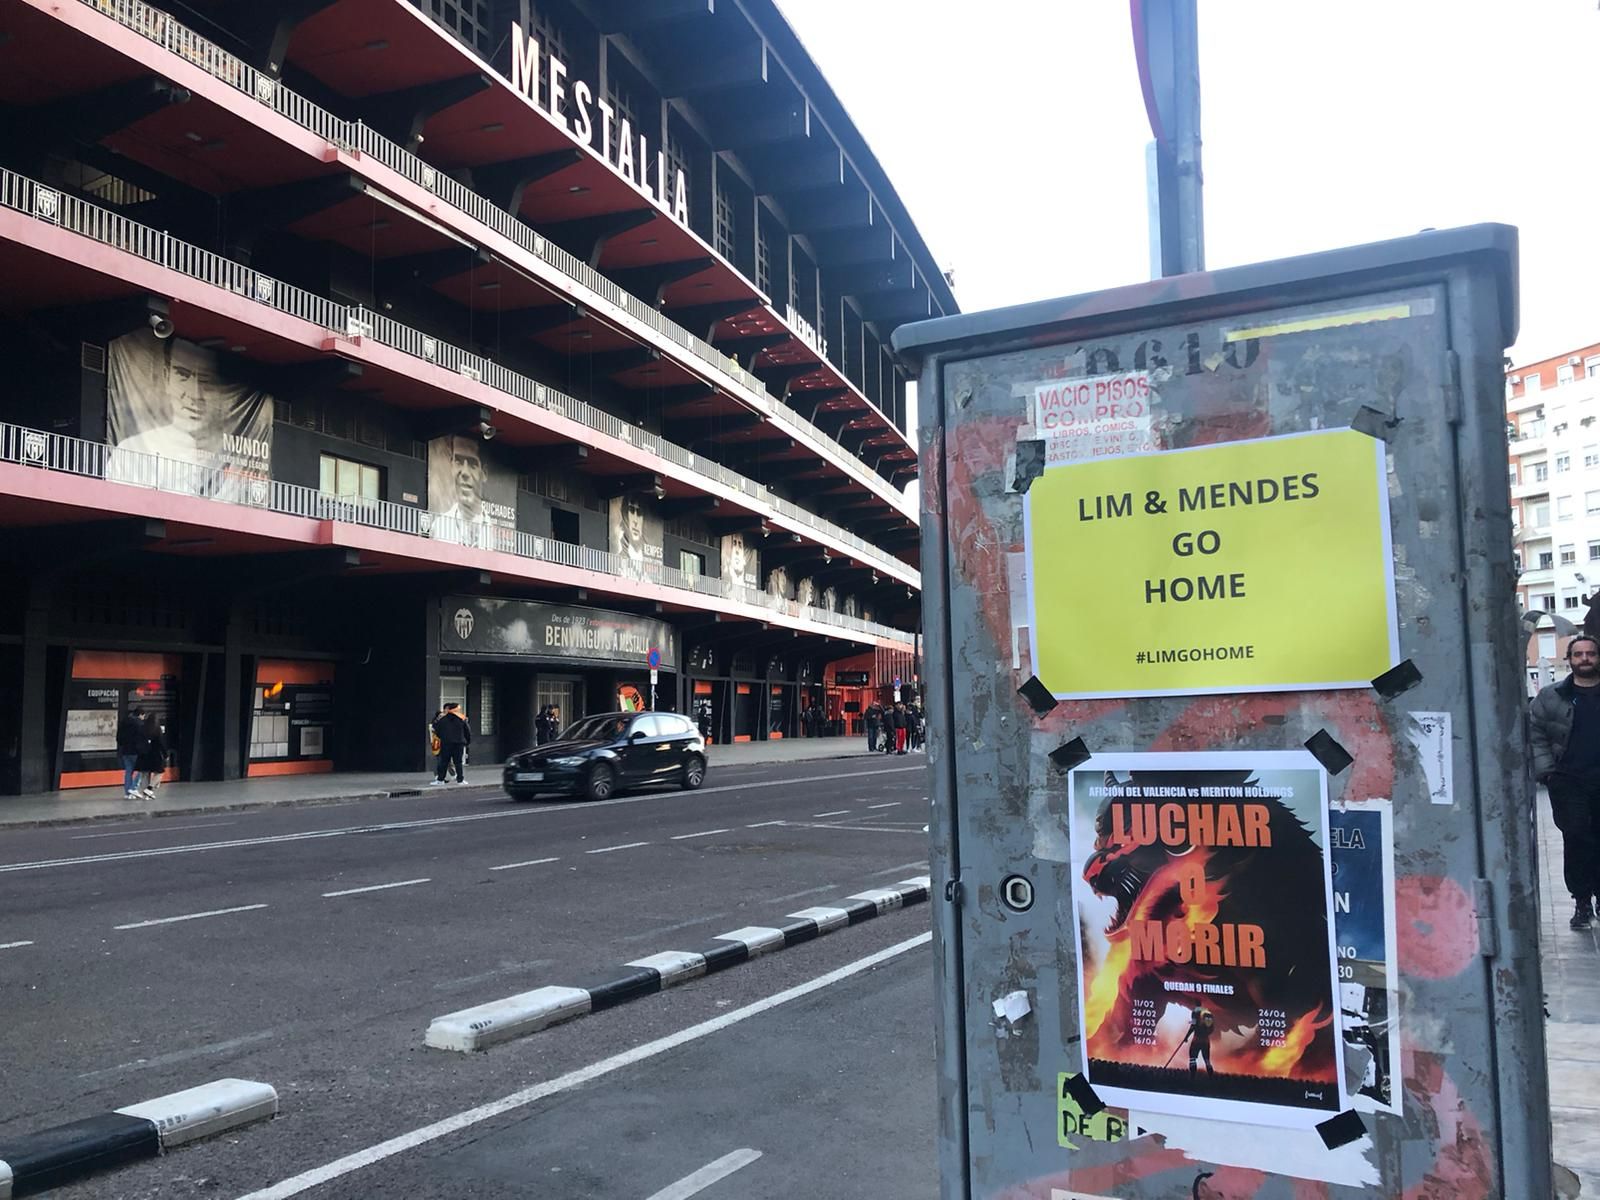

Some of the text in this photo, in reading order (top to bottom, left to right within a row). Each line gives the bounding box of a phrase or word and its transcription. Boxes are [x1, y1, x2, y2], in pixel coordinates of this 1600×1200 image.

[510, 20, 690, 228] MESTALLA
[1039, 376, 1150, 410] VACIO PISOS
[223, 433, 269, 459] MUNDO
[1078, 472, 1320, 521] LIM & MENDES
[1172, 529, 1221, 557] GO
[1145, 573, 1246, 603] HOME
[545, 625, 611, 650] BENVINGUTS
[1136, 645, 1254, 664] #LIMGOHOME
[1089, 785, 1294, 799] AFICIÓN DEL VALENCIA vs MERITON HOLDINGS
[1111, 802, 1272, 847] LUCHAR
[1179, 861, 1207, 906] O
[1128, 918, 1267, 969] MORIR
[1164, 981, 1234, 995] QUEDAN 9 FINALES
[1132, 1008, 1157, 1018] 26/02
[1133, 999, 1155, 1009] 11/02
[1258, 1008, 1286, 1019] 26/04
[1133, 1018, 1156, 1028] 12/03
[1258, 1018, 1287, 1029] 03/05
[1133, 1036, 1157, 1046] 16/04
[1260, 1028, 1286, 1039] 21/05
[1260, 1037, 1287, 1048] 28/05
